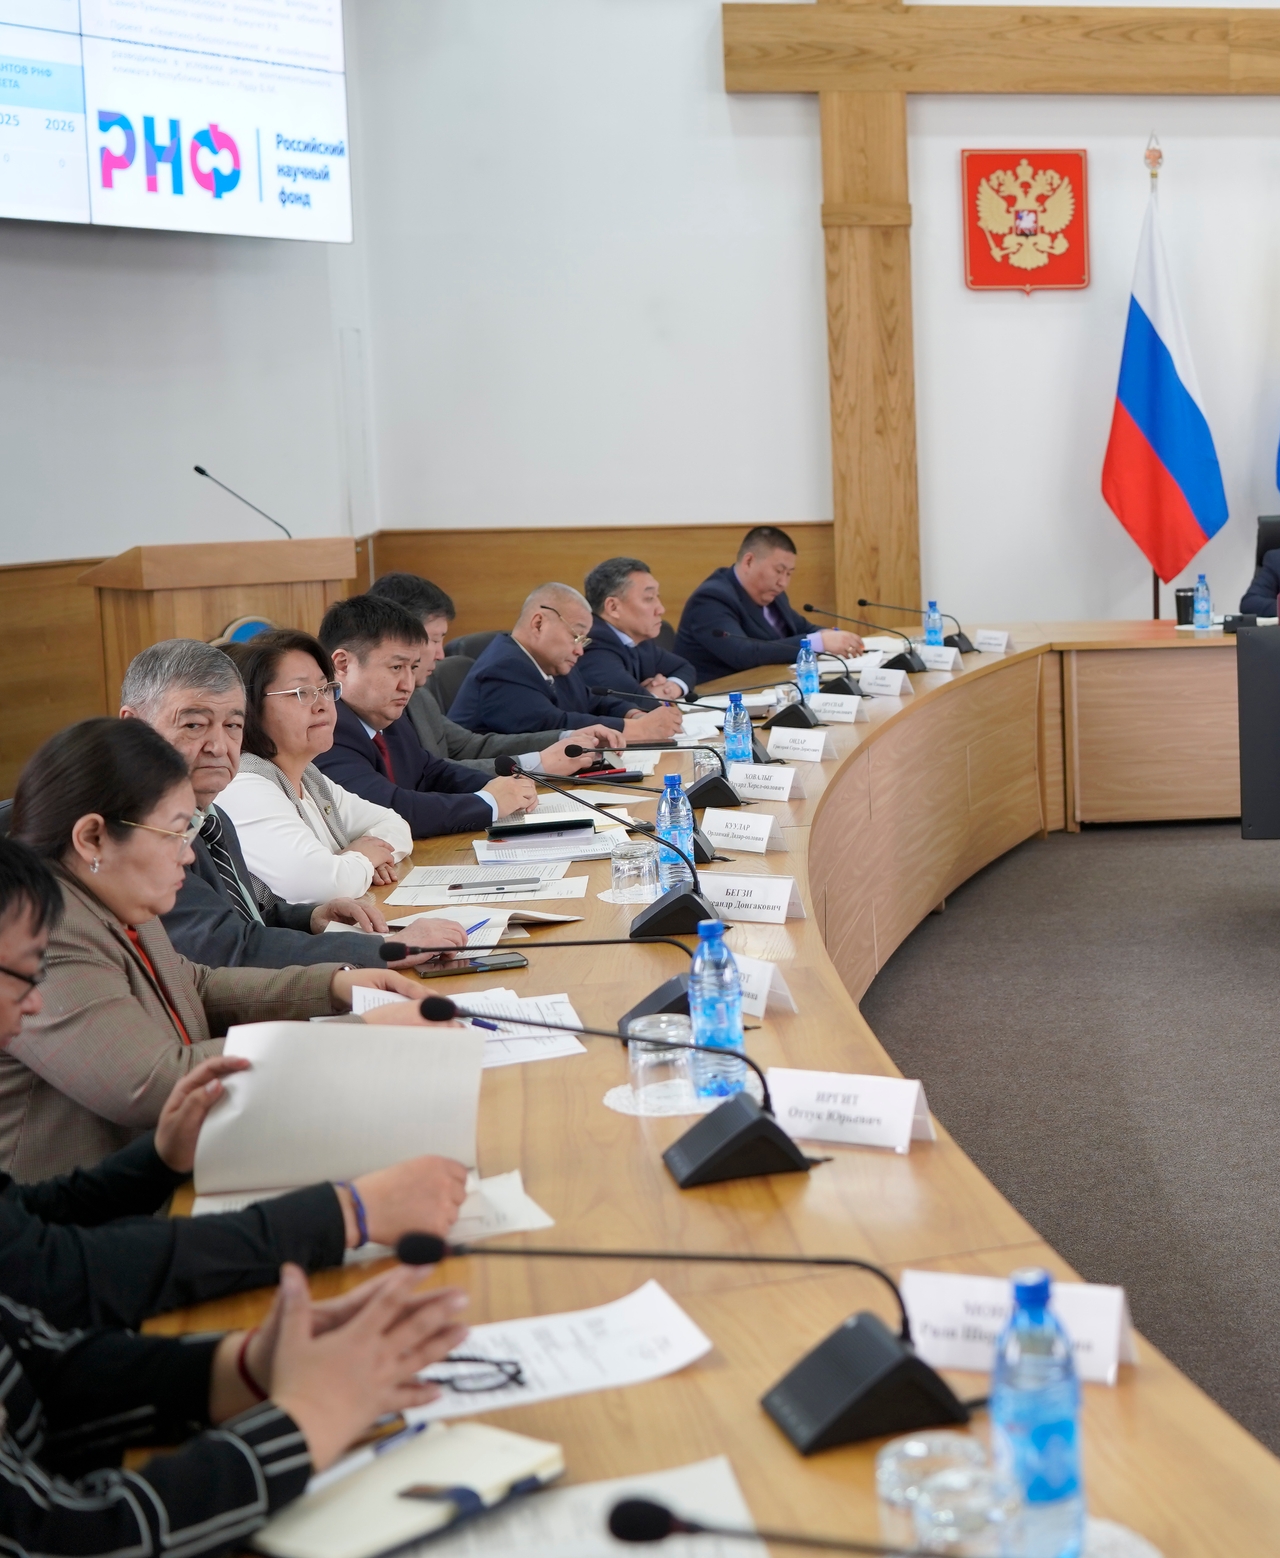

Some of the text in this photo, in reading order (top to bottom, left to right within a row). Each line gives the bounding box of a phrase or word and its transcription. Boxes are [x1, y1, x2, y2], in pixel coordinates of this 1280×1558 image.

[31, 66, 53, 77] РНФ
[45, 118, 75, 132] 2026
[276, 133, 346, 157] Российский
[98, 109, 241, 199] РНФ
[277, 164, 330, 183] научный
[278, 187, 312, 208] фонд
[744, 772, 774, 781] ХОВАЛЫГ
[724, 821, 751, 831] КУУЛАР
[725, 888, 753, 898] БЕГЗИ
[734, 900, 781, 911] Донгакович
